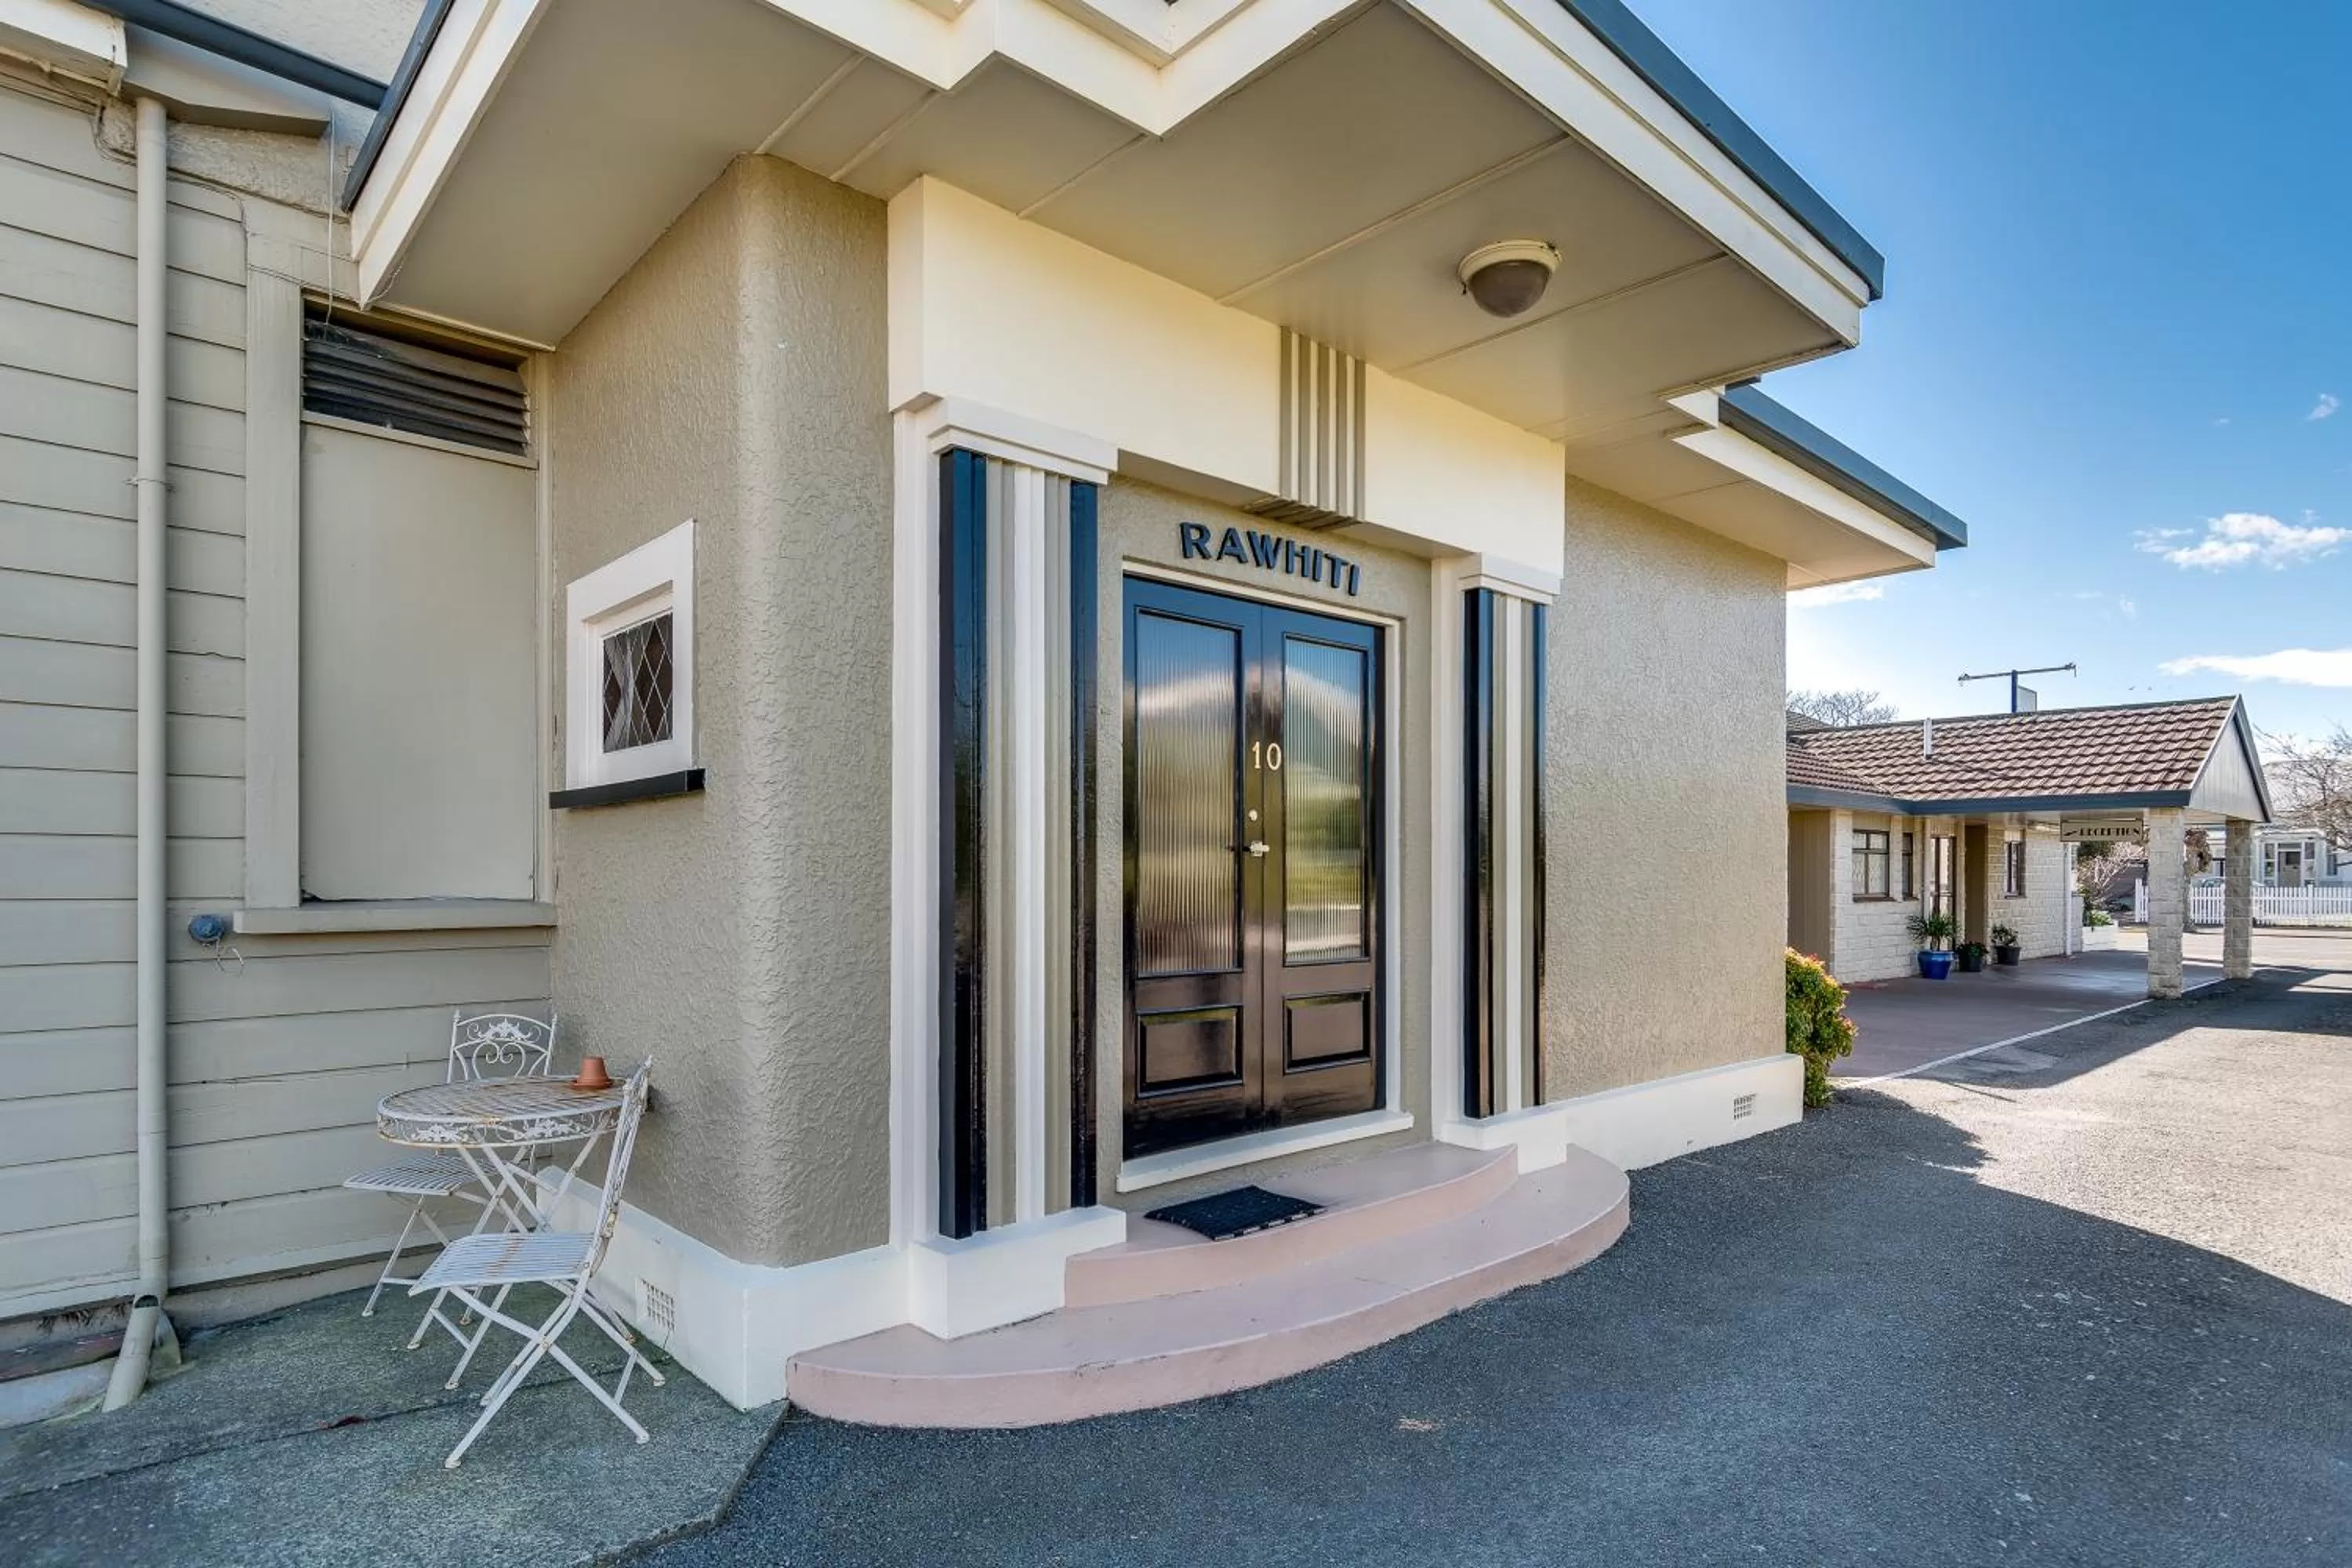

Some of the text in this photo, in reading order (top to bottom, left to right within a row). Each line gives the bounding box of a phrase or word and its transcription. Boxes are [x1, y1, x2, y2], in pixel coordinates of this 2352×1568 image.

[1180, 521, 1360, 596] RAWHITI
[1251, 741, 1282, 771] 10
[2079, 827, 2140, 837] RECEPTION
